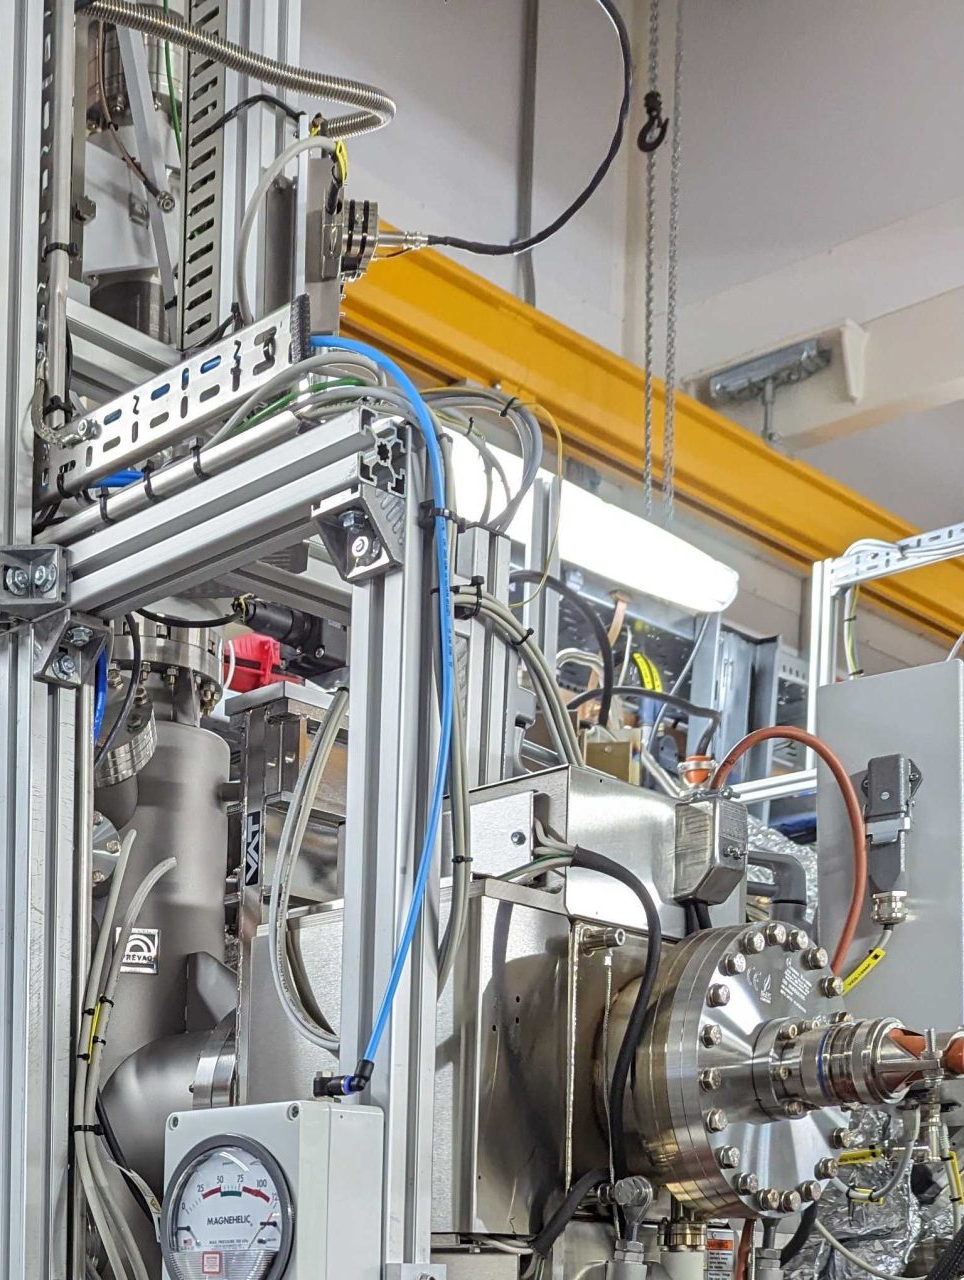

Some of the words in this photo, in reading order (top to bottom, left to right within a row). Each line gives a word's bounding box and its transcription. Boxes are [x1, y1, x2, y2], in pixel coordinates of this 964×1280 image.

[246, 815, 260, 884] VAT
[216, 1175, 224, 1184] 50
[237, 1174, 244, 1183] 75
[197, 1184, 205, 1192] 25
[256, 1179, 267, 1188] 100
[181, 1202, 186, 1210] 0
[206, 1214, 251, 1226] MAGNEHELIC
